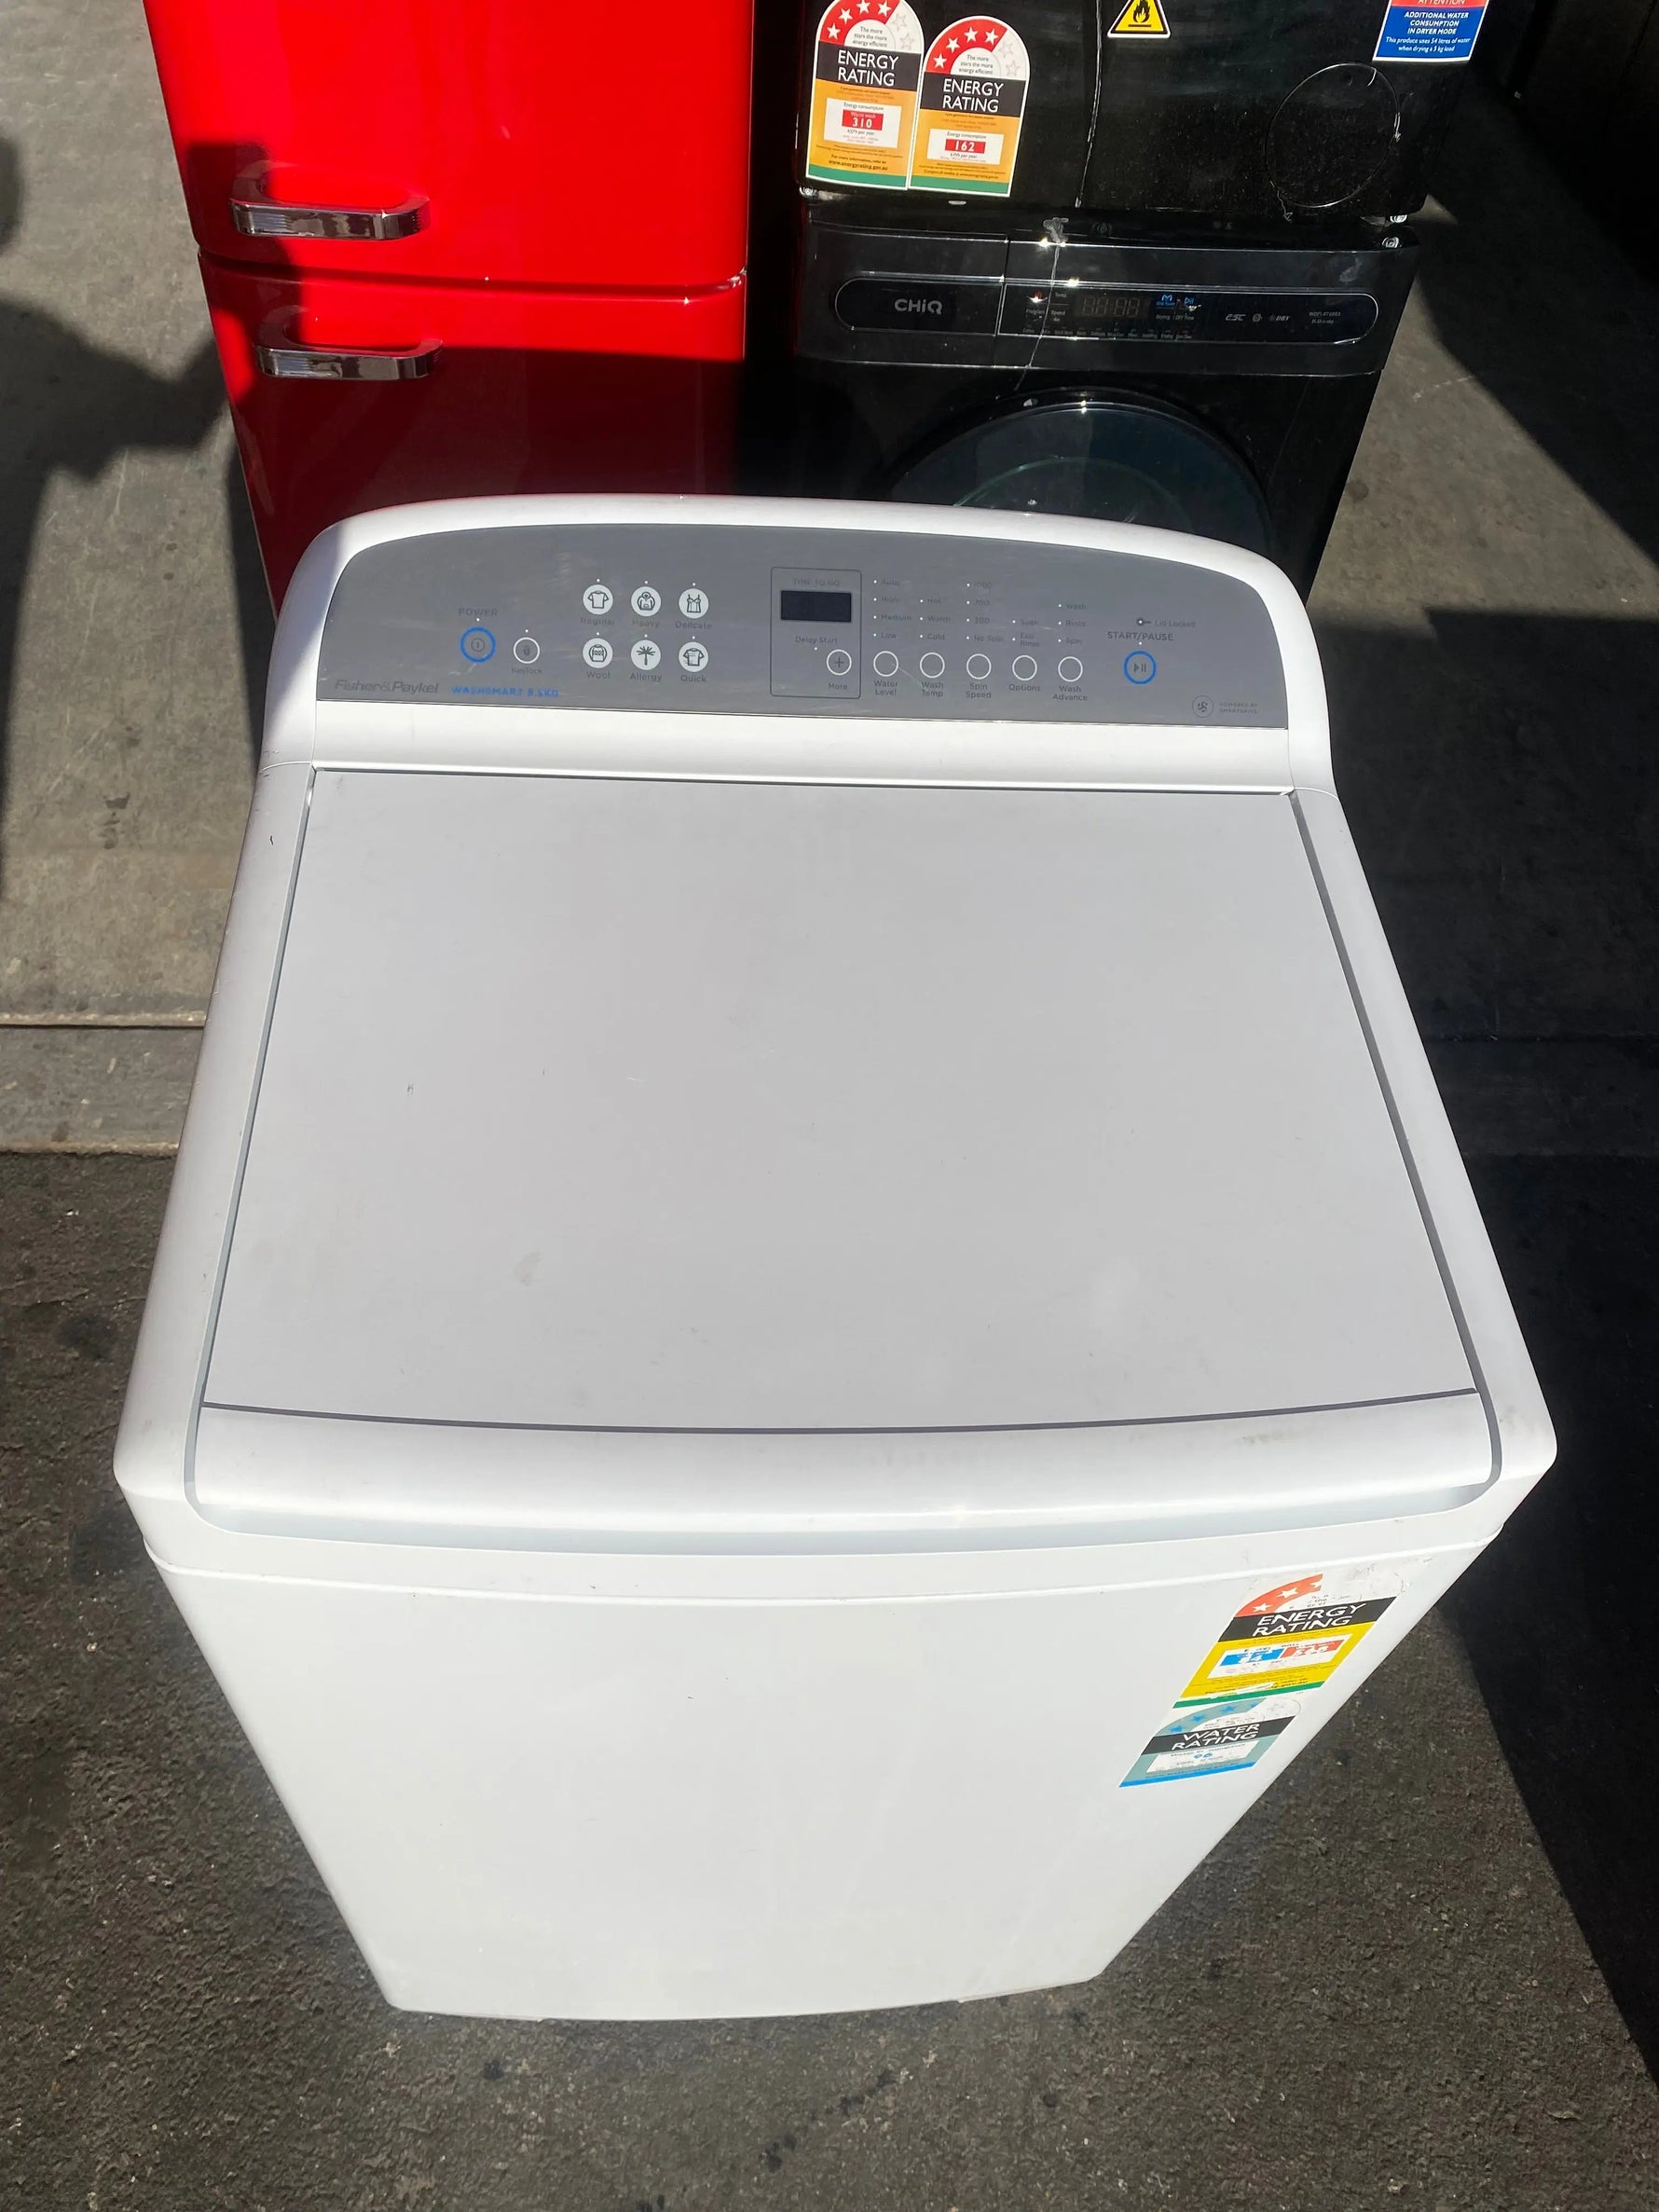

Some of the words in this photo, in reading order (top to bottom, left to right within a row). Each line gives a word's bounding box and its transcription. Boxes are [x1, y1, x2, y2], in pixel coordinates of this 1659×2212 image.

[838, 49, 899, 70] ENERGY
[838, 67, 895, 87] RATING
[943, 78, 1004, 97] ENERGY
[942, 95, 999, 113] RATING
[852, 117, 872, 129] 310
[955, 140, 975, 152] 162
[894, 298, 942, 315] CHiQ
[459, 608, 498, 616] POWER
[675, 620, 713, 630] Delicate
[795, 636, 817, 644] Delay
[1107, 631, 1174, 641] START/PAUSE
[586, 670, 610, 680] Wool
[630, 673, 662, 682] Allergy
[680, 674, 707, 682] Quick
[828, 682, 847, 691] More
[873, 680, 898, 688] Water
[1008, 683, 1041, 692] Options
[451, 686, 523, 696] WASHSMART
[922, 690, 943, 698] Temp
[966, 691, 992, 699] Speed
[1257, 1603, 1366, 1626] ENERGY
[1253, 1616, 1353, 1637] RATING
[1184, 1724, 1260, 1741] WATER
[1171, 1731, 1259, 1751] RATING
